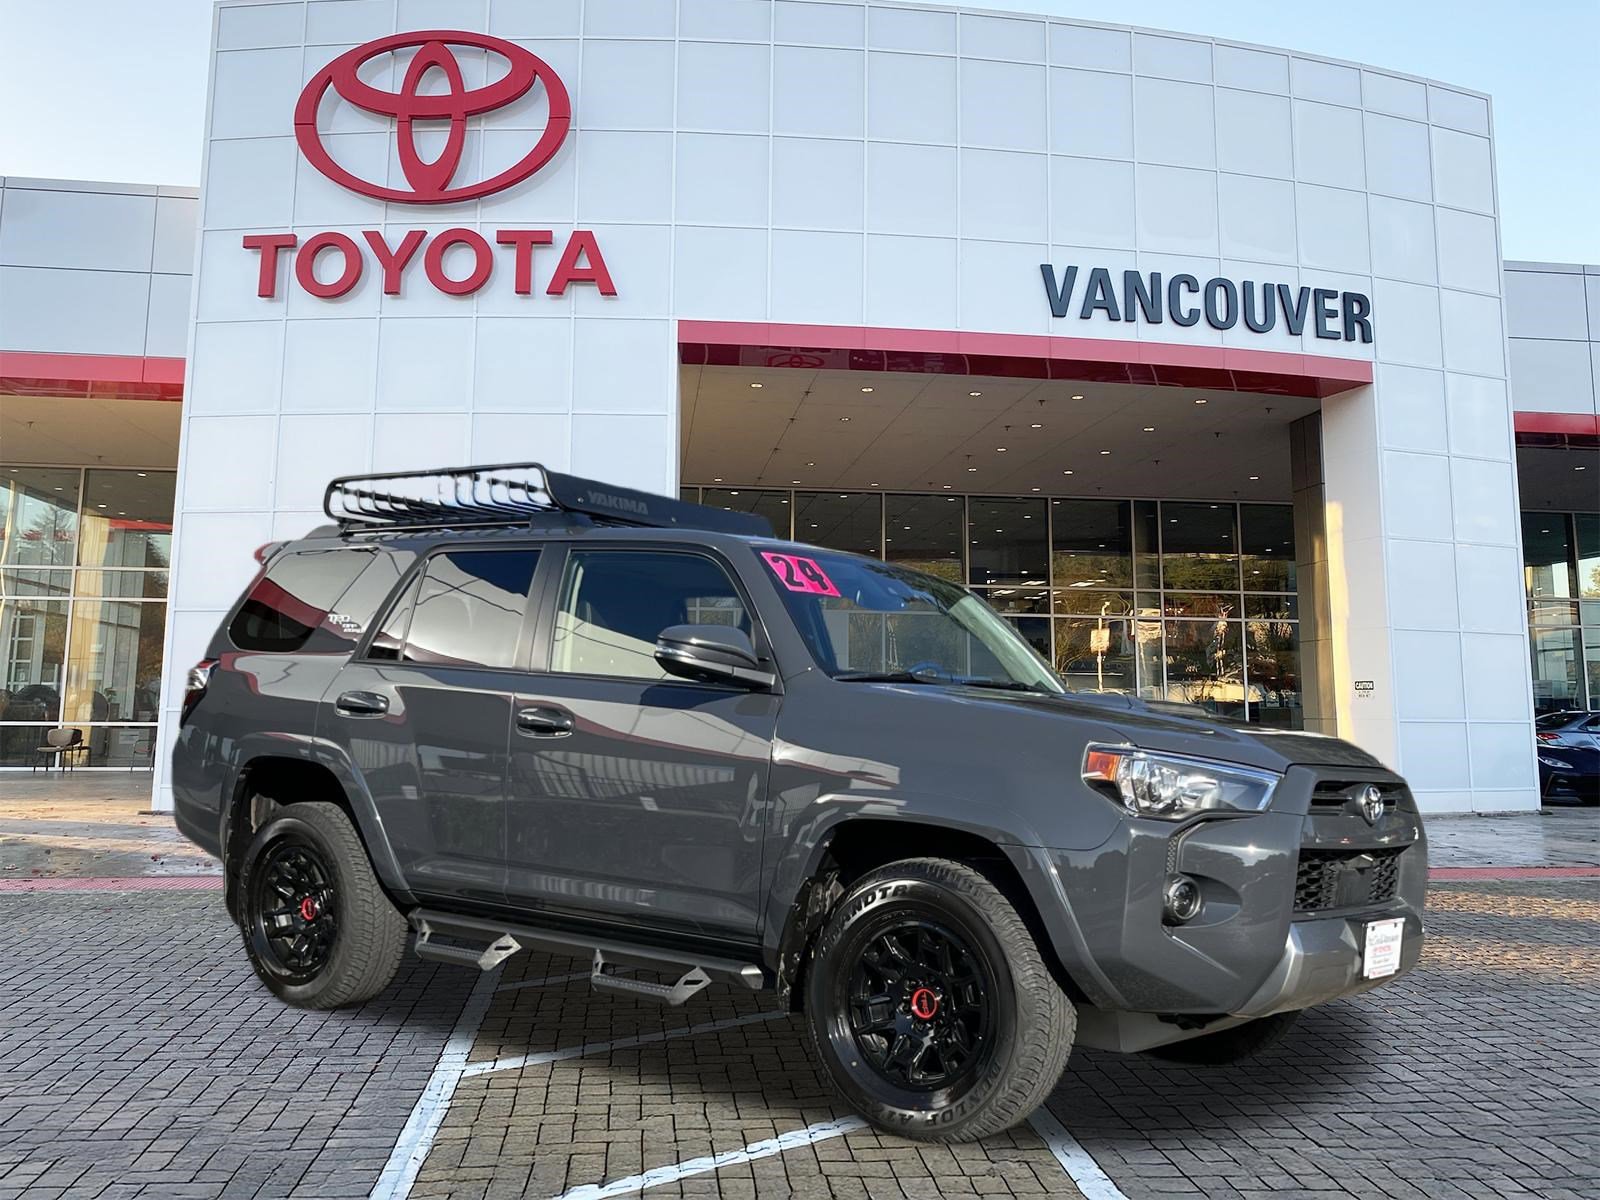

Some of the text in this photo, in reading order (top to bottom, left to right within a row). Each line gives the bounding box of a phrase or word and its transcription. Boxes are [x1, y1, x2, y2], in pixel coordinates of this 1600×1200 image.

[243, 229, 618, 298] TOYOTA
[1040, 263, 1373, 343] VANCOUVER
[588, 491, 648, 514] YAKIMA
[771, 556, 829, 590] 24
[327, 614, 350, 625] TRD
